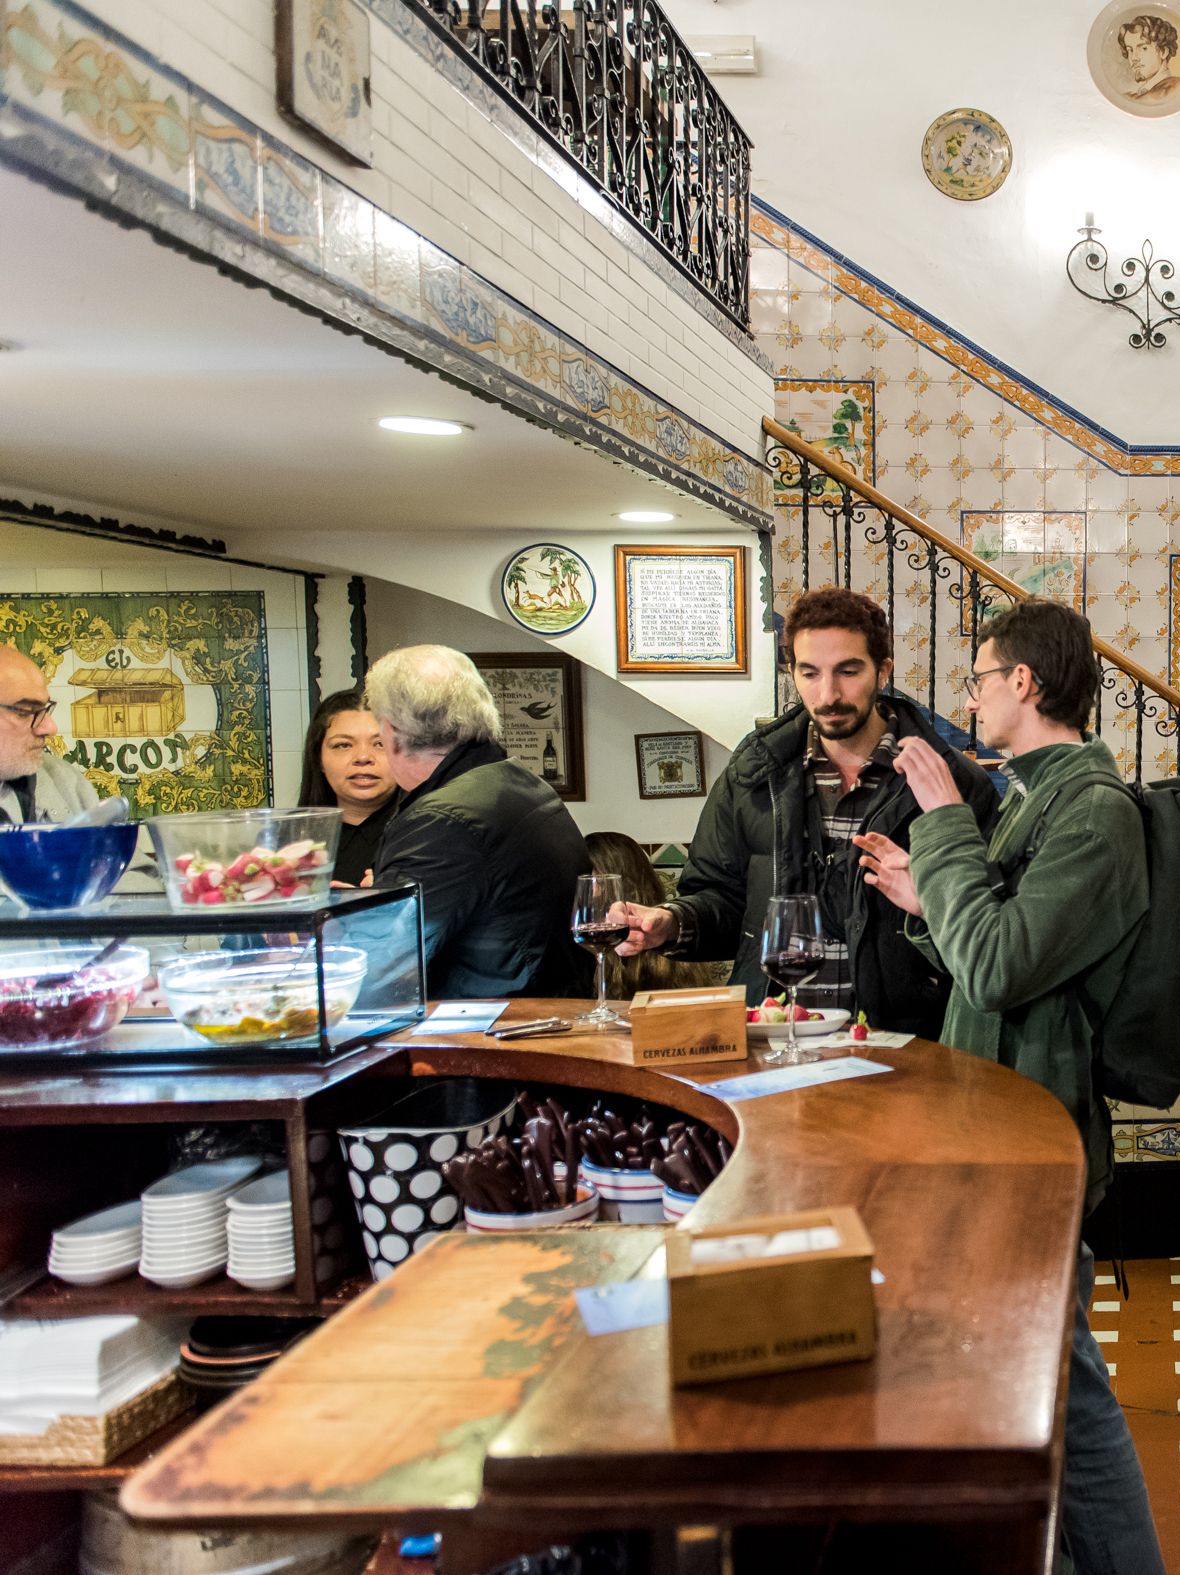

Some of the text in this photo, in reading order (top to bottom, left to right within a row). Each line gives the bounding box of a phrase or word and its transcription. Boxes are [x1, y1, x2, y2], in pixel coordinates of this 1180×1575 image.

[105, 648, 131, 669] EL
[643, 1044, 737, 1059] CERVEZAS ALHAMBRA
